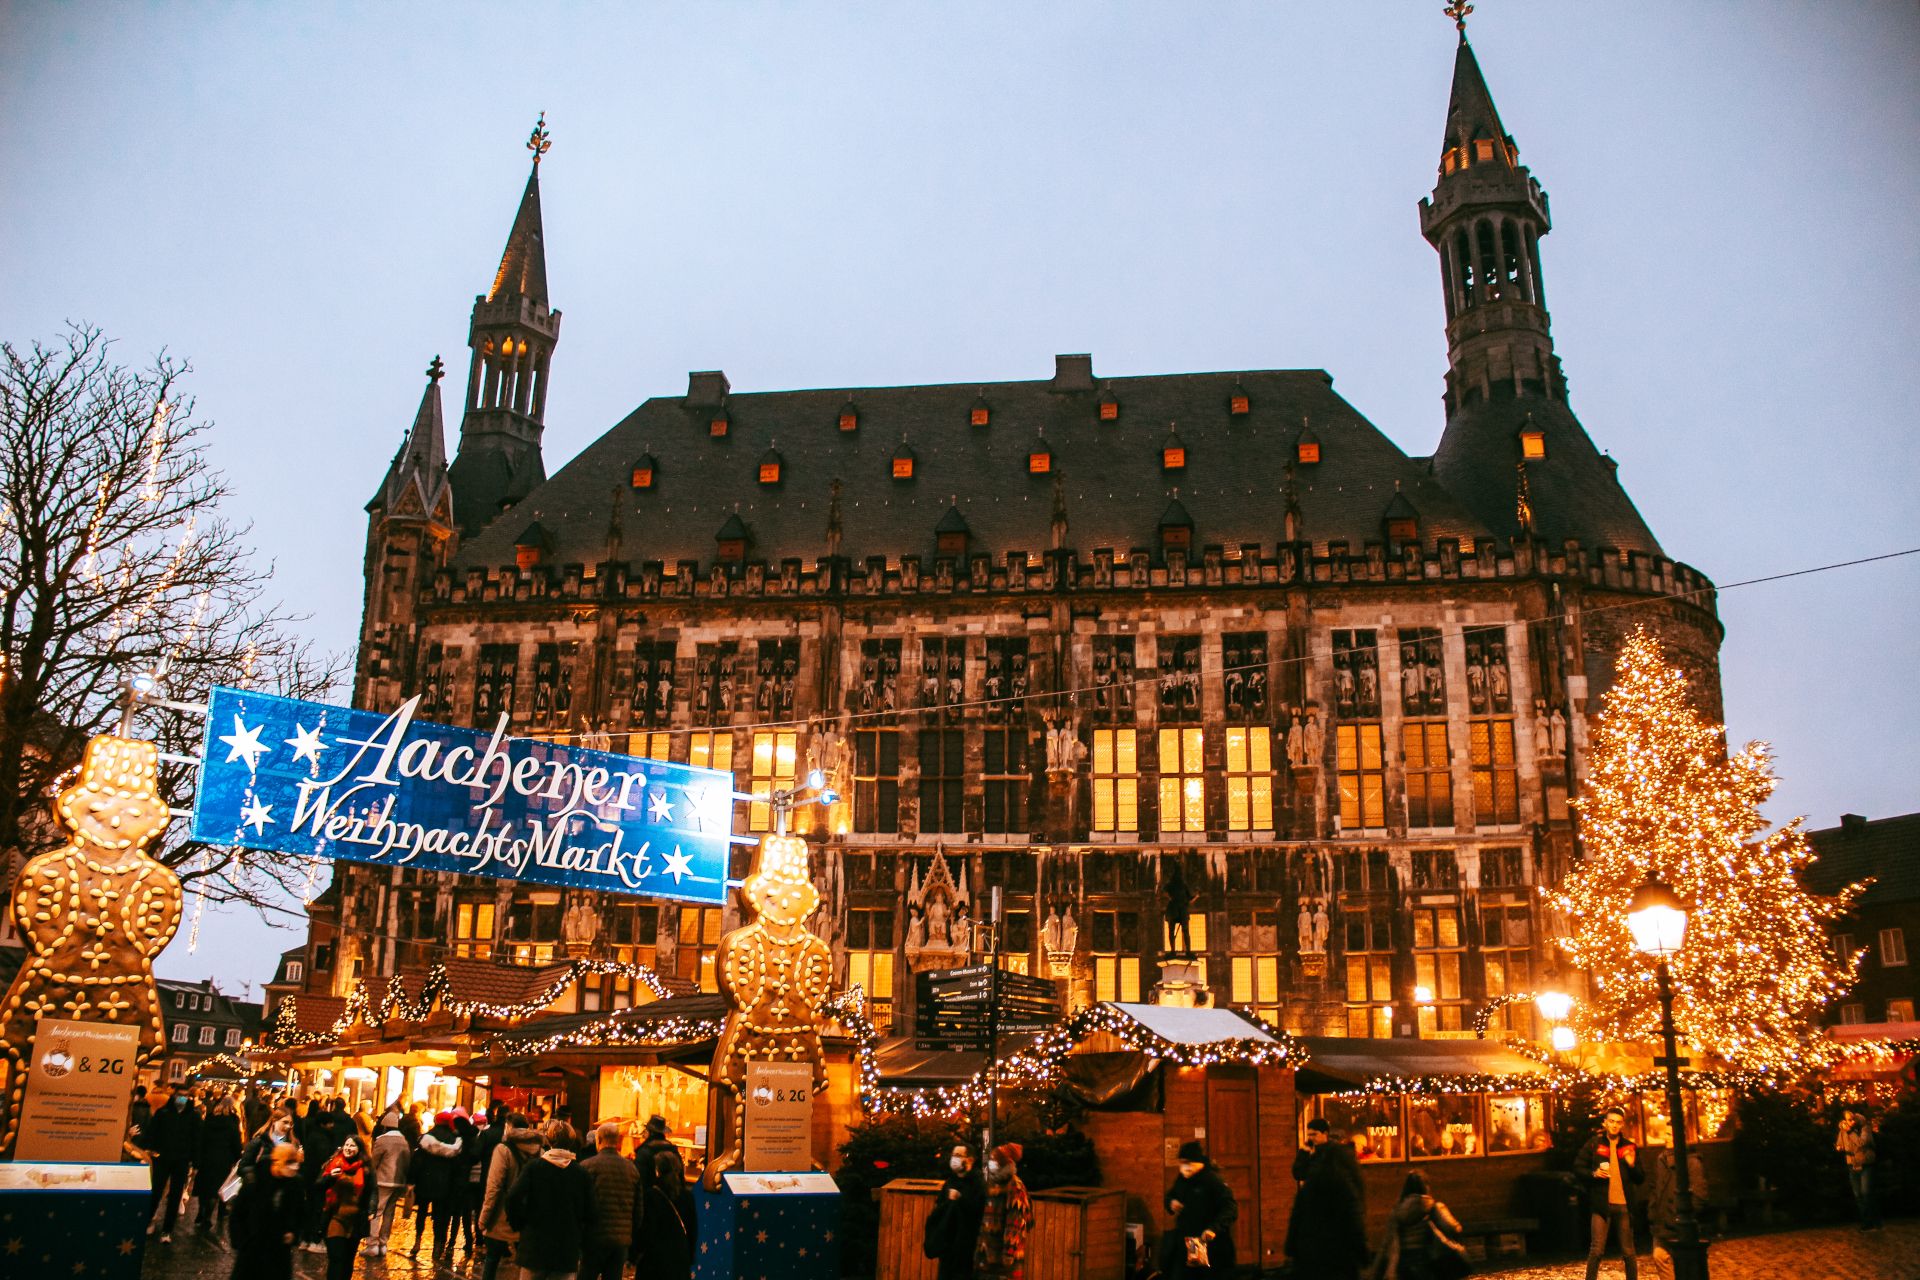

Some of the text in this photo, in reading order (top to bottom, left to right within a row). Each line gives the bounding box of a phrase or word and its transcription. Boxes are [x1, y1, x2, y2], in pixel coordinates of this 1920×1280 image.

[303, 694, 647, 818] Aachener
[291, 783, 652, 888] WeihnachtsMarkt
[79, 1056, 124, 1075] & 2G
[777, 1089, 805, 1102] & 2G
